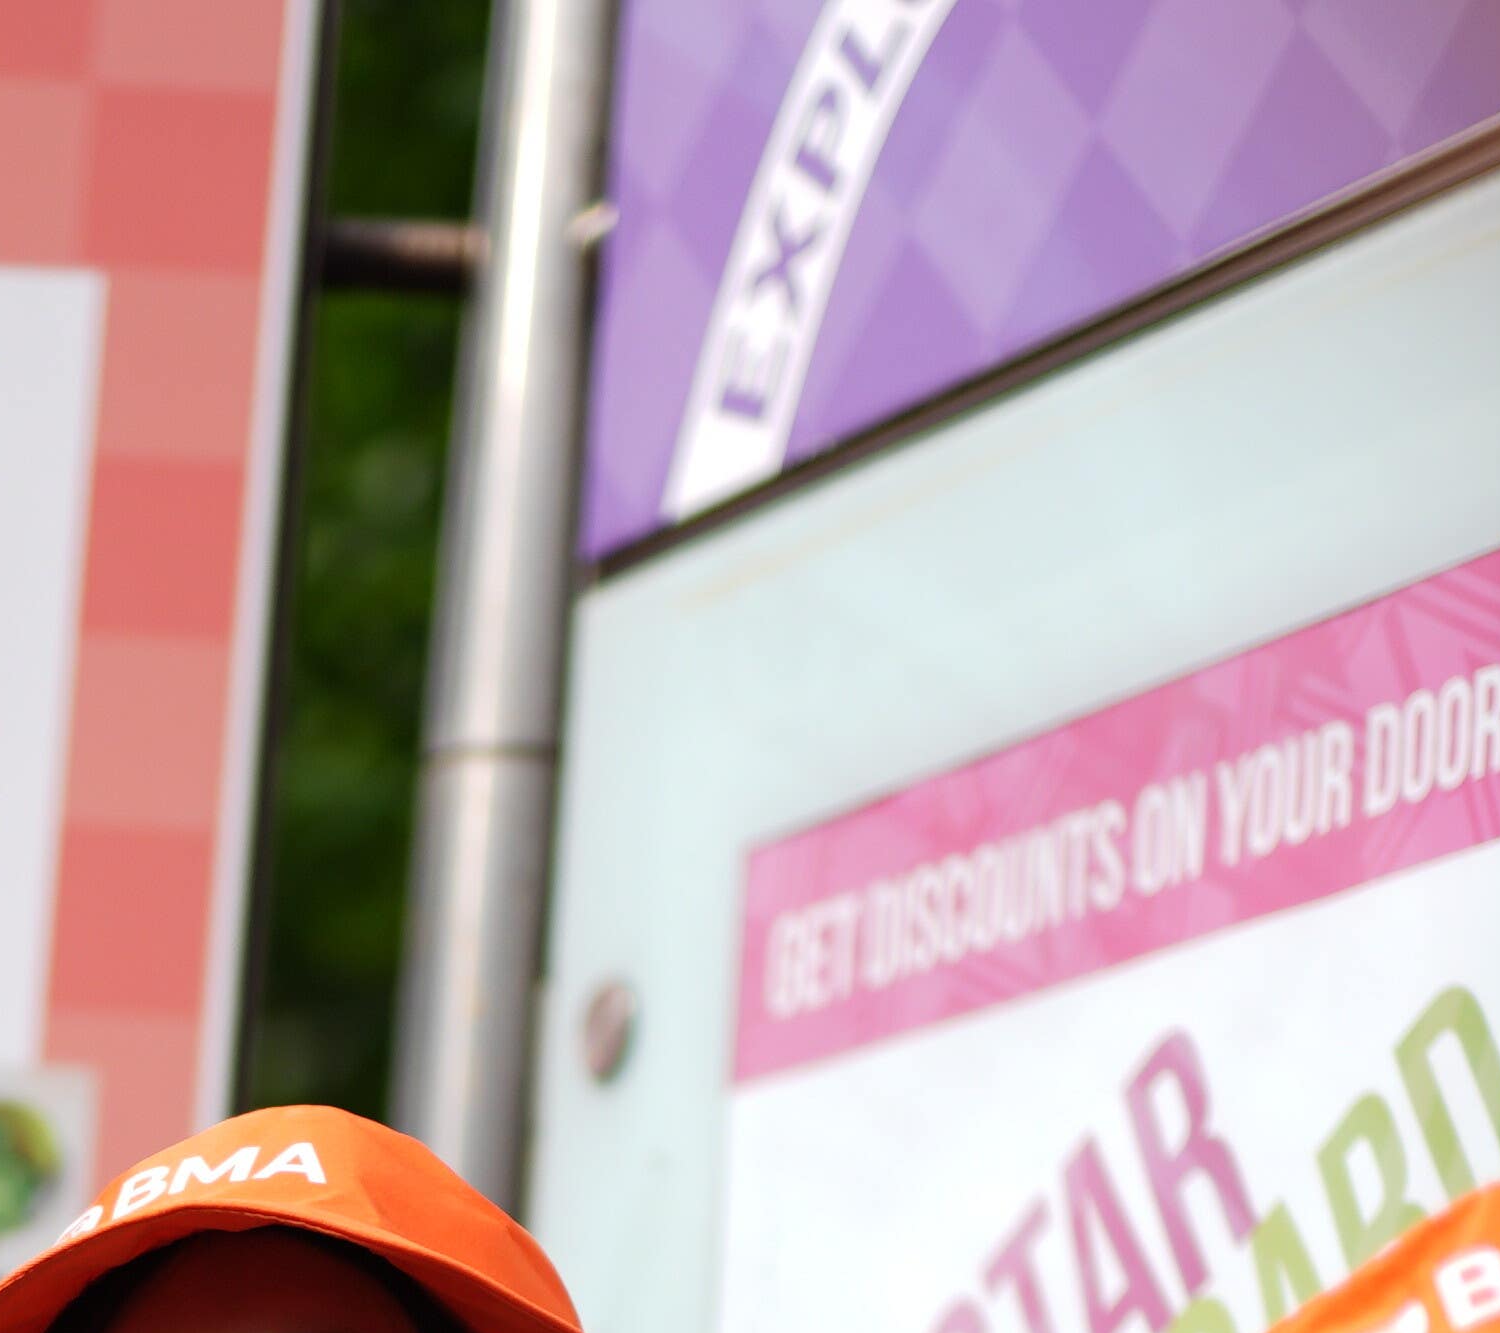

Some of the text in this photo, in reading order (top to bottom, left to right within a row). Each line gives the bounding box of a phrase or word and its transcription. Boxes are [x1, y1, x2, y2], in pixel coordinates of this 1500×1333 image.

[716, 0, 935, 420] EXPL
[766, 904, 858, 1019] GET
[861, 801, 1126, 990] DISCOUNTS
[1135, 772, 1205, 898] ON
[1217, 724, 1352, 867] YOUR
[112, 1142, 327, 1221] BMA
